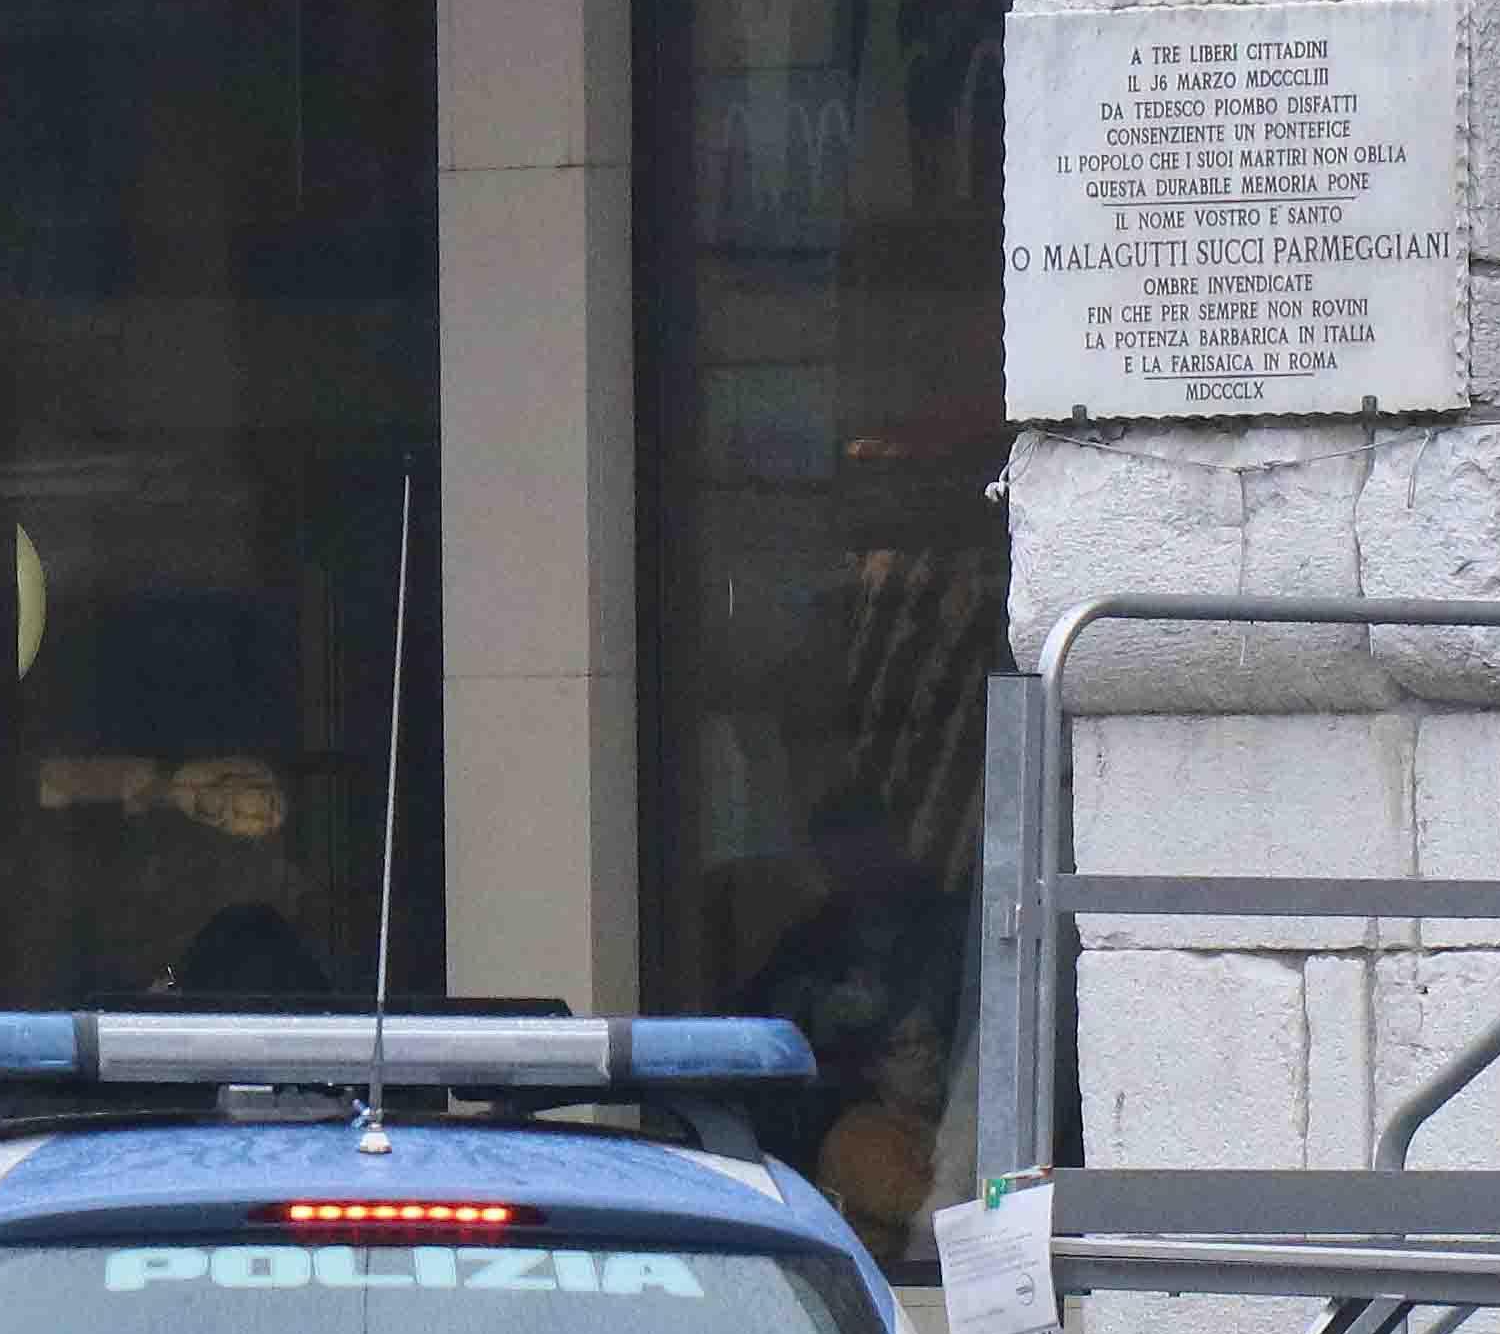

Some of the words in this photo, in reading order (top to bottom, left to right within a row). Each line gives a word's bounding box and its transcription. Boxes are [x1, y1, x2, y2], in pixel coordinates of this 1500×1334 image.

[1130, 46, 1143, 66] A
[1151, 44, 1182, 66] TRE
[1189, 42, 1239, 64] LIBERI
[1245, 39, 1329, 61] CITTADINI
[1127, 74, 1142, 93] IL
[1176, 71, 1237, 92] MARZO
[1100, 101, 1125, 122] DA
[1133, 99, 1206, 121] TEDESCO
[1214, 96, 1279, 118] PIOMBO
[1287, 93, 1358, 115] DISFATTI
[1106, 123, 1226, 147] CONSENZIENTE
[1233, 122, 1256, 143] UN
[1264, 118, 1352, 141] PONTEFICE
[1057, 155, 1073, 175] IL
[1078, 152, 1144, 174] POPOLO
[1149, 151, 1180, 171] CHE
[1185, 151, 1192, 170] I
[1196, 149, 1234, 169] SUOI
[1239, 147, 1308, 169] MARTIRI
[1312, 145, 1349, 166] NON
[1353, 143, 1407, 165] OBLIA
[1085, 178, 1147, 199] QUESTA
[1155, 176, 1232, 198] DURABILE
[1240, 173, 1319, 195] MEMORIA
[1327, 171, 1372, 192] PONE
[1115, 211, 1130, 232] IL
[1138, 210, 1186, 231] NOME
[1193, 208, 1261, 228] VOSTRO
[1287, 204, 1343, 225] SANTO
[1011, 245, 1032, 273] O
[1042, 239, 1189, 273] MALAGUTTI
[1195, 236, 1265, 266] SUCCI
[1272, 231, 1451, 266] PARMEGGIANI
[1143, 276, 1200, 297] OMBRE
[1207, 273, 1314, 295] INVENDICATE
[1087, 305, 1113, 325] FIN
[1120, 304, 1153, 324] CHE
[1160, 303, 1190, 323] PER
[1197, 301, 1259, 322] SEMPRE
[1267, 299, 1303, 321] NON
[1311, 297, 1369, 318] ROVINI
[1084, 331, 1107, 351] LA
[1114, 329, 1190, 351] POTENZA
[1199, 326, 1290, 347] BARBARICA
[1298, 324, 1315, 345] IN
[1323, 322, 1376, 344] ITALIA
[1123, 355, 1134, 375] E
[1141, 354, 1163, 374] LA
[1170, 353, 1255, 374] FARISAICA
[1263, 352, 1281, 372] IN
[1288, 350, 1339, 371] ROMA
[1185, 380, 1265, 402] MDCCCLX
[104, 1245, 705, 1298] POLIZIA
